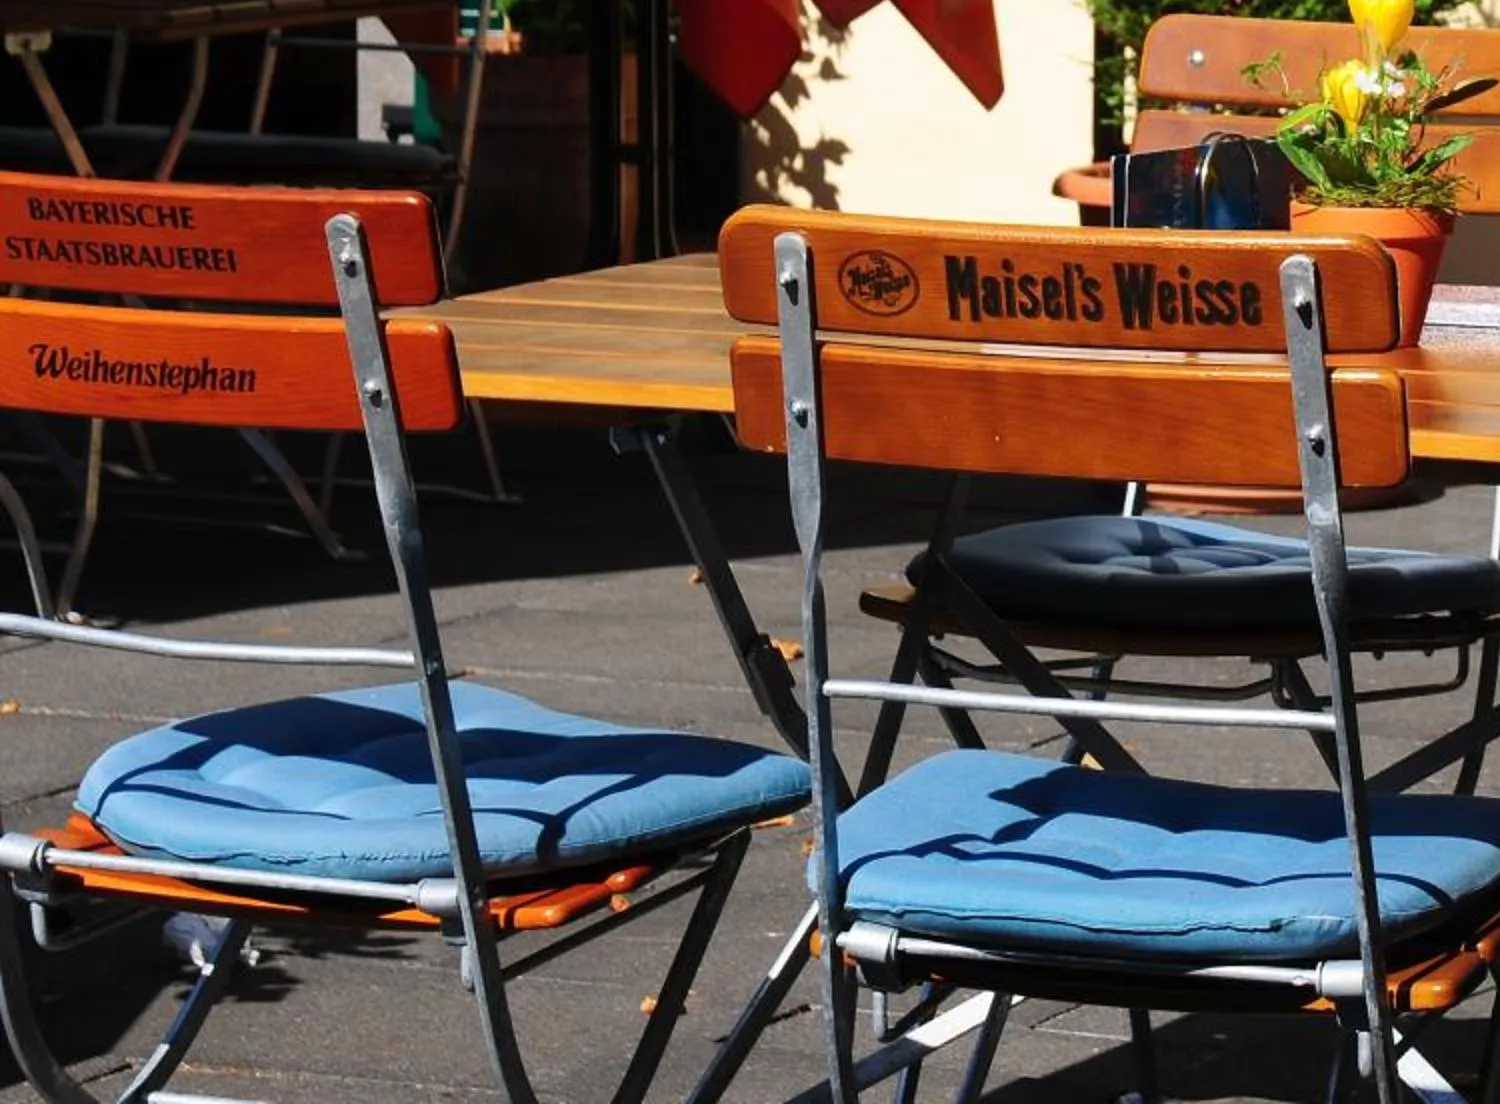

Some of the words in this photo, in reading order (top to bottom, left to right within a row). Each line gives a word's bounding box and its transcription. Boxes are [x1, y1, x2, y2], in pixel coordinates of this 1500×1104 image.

[28, 198, 197, 230] BAYERISCHE
[6, 236, 237, 272] STAATSBRAUEREI
[944, 255, 1104, 323] Maisel's
[1112, 262, 1263, 330] Weisse
[29, 343, 256, 394] Weihenstephan
